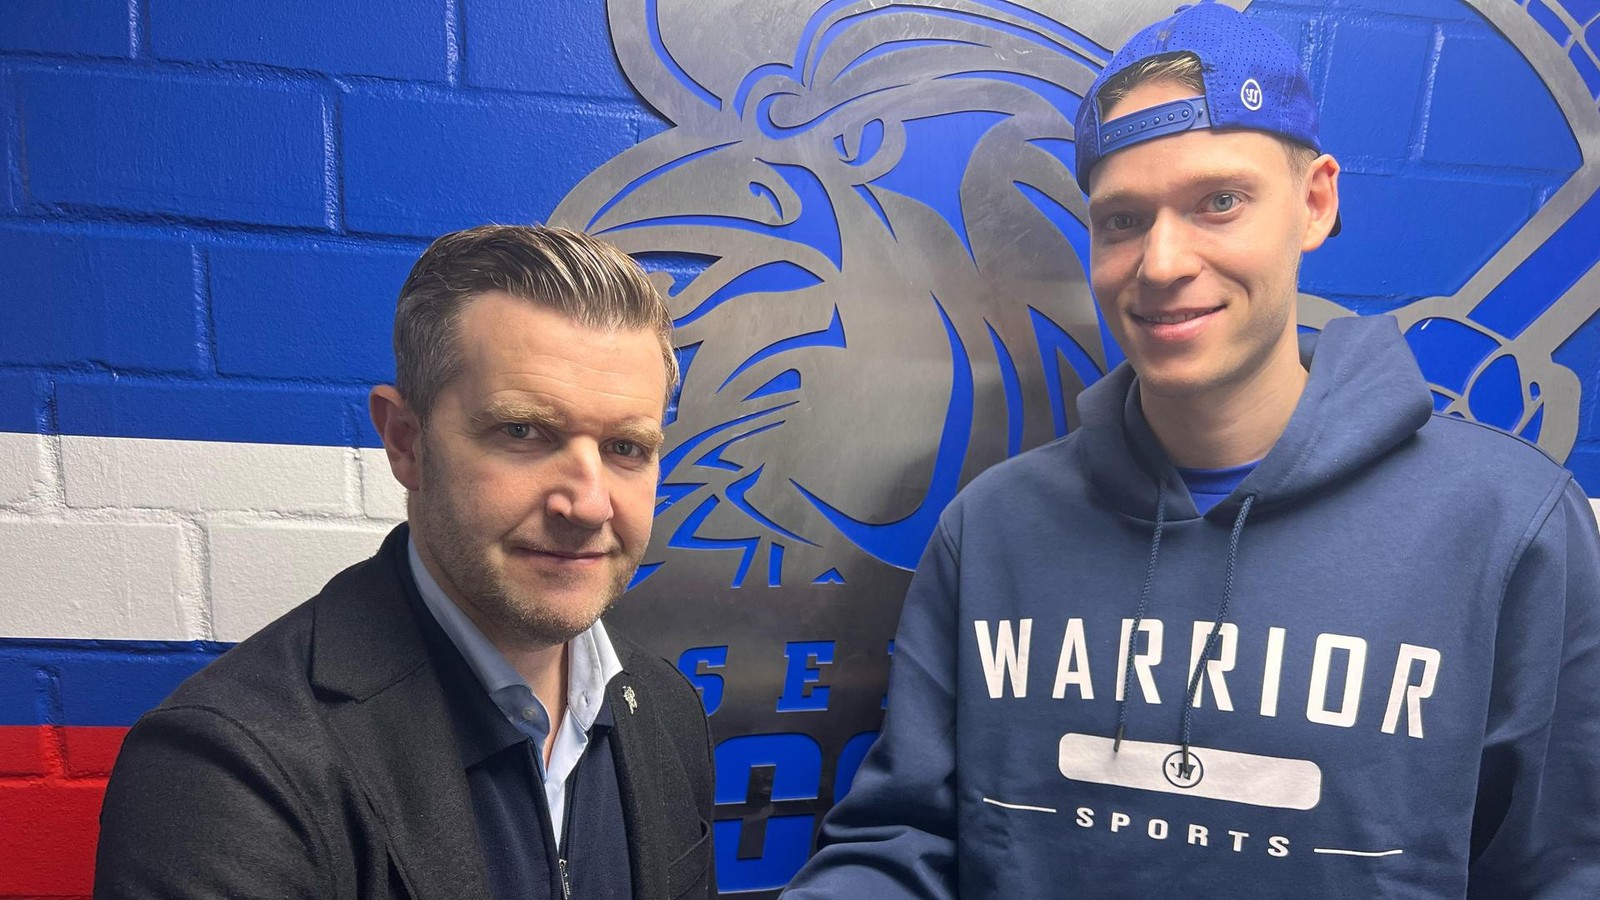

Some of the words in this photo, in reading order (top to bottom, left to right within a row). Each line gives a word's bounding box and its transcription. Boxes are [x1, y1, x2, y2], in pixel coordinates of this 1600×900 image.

[677, 640, 895, 717] SE
[974, 618, 1441, 738] WARRIOR
[1075, 806, 1290, 858] SPORTS
